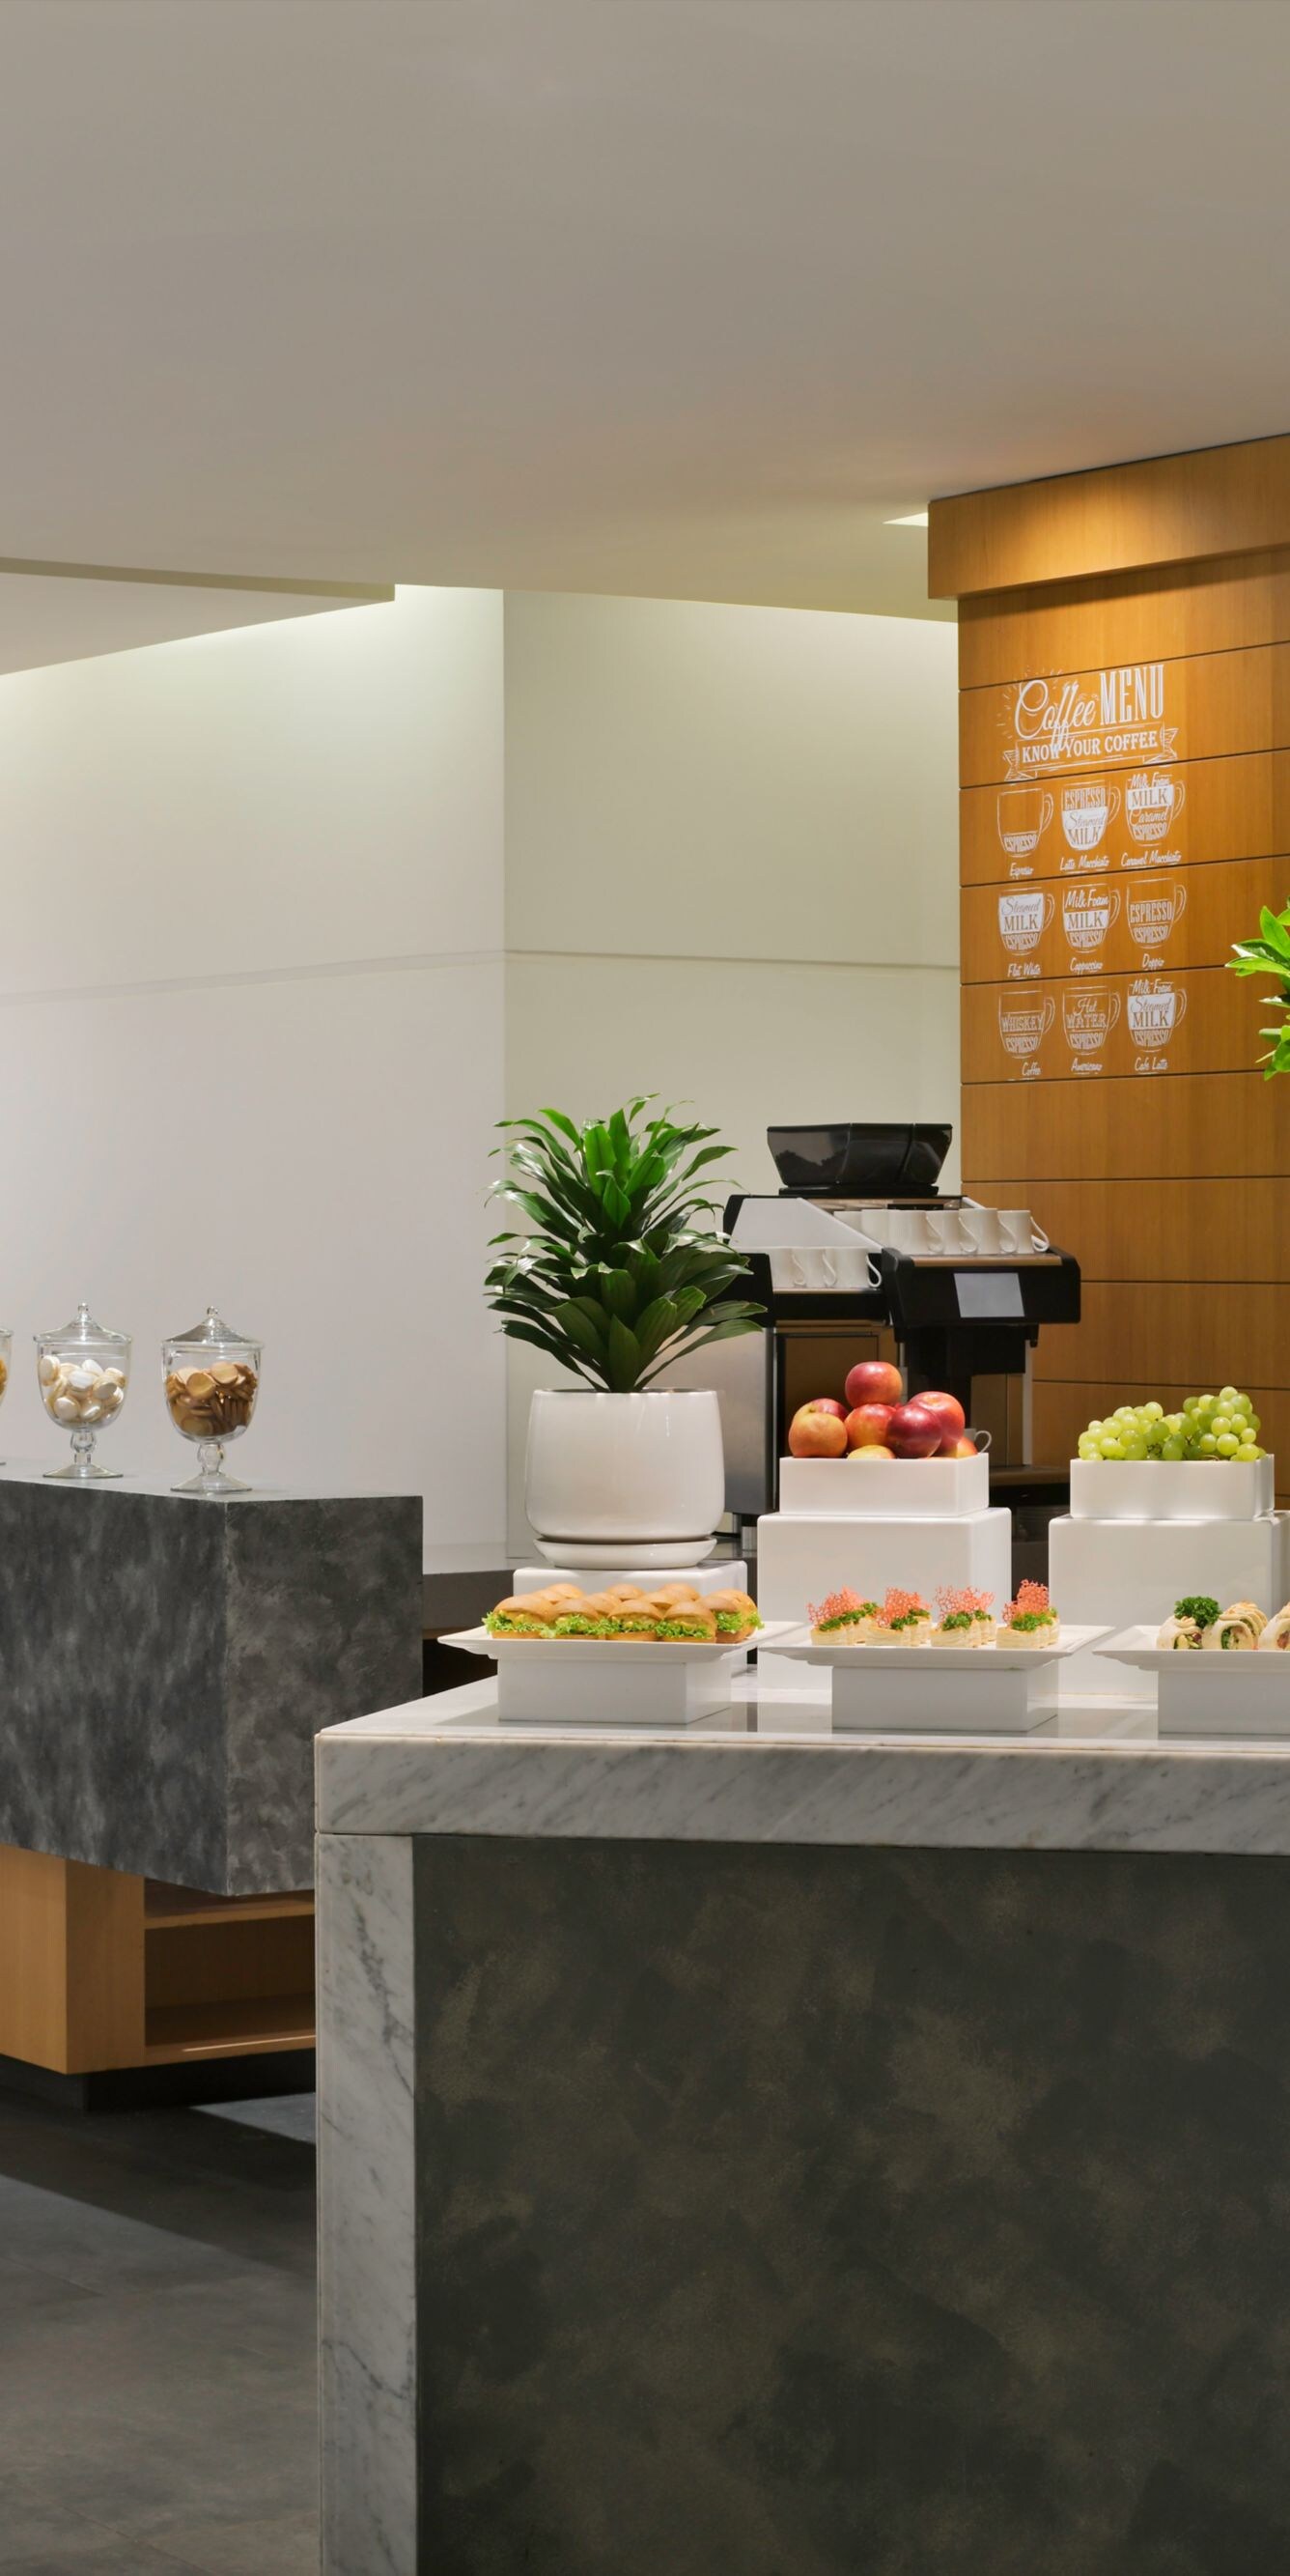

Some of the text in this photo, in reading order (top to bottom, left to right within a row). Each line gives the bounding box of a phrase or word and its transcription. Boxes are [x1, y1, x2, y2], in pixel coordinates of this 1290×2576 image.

[1015, 664, 1164, 751] Coffee MENU
[1022, 730, 1159, 763] KNOW YOUR COFFEE
[1064, 787, 1107, 809] ESPRESSO
[1132, 787, 1168, 807] MILK
[1068, 827, 1102, 846] MILK
[1132, 823, 1167, 841] ESPRESSO
[1003, 834, 1038, 853] ESPRESSO
[1001, 898, 1041, 916] Steamed
[1065, 891, 1086, 909] Milk
[1067, 911, 1104, 930] MILK
[1130, 901, 1172, 923] ESPRESSO
[1003, 913, 1039, 932] MILK
[1004, 933, 1040, 950] ESPRESSO
[1067, 929, 1104, 948] ESPRESSO
[1133, 924, 1169, 943] ESPRESSO
[1131, 995, 1172, 1012] Steamed
[1002, 1012, 1045, 1033] WHISKEY
[1065, 1012, 1107, 1030] WATER
[1133, 1010, 1168, 1029] MILK
[1005, 1036, 1040, 1054] ESPRESSO
[1068, 1032, 1105, 1051] ESPRESSO
[1133, 1029, 1169, 1047] ESPRESSO
